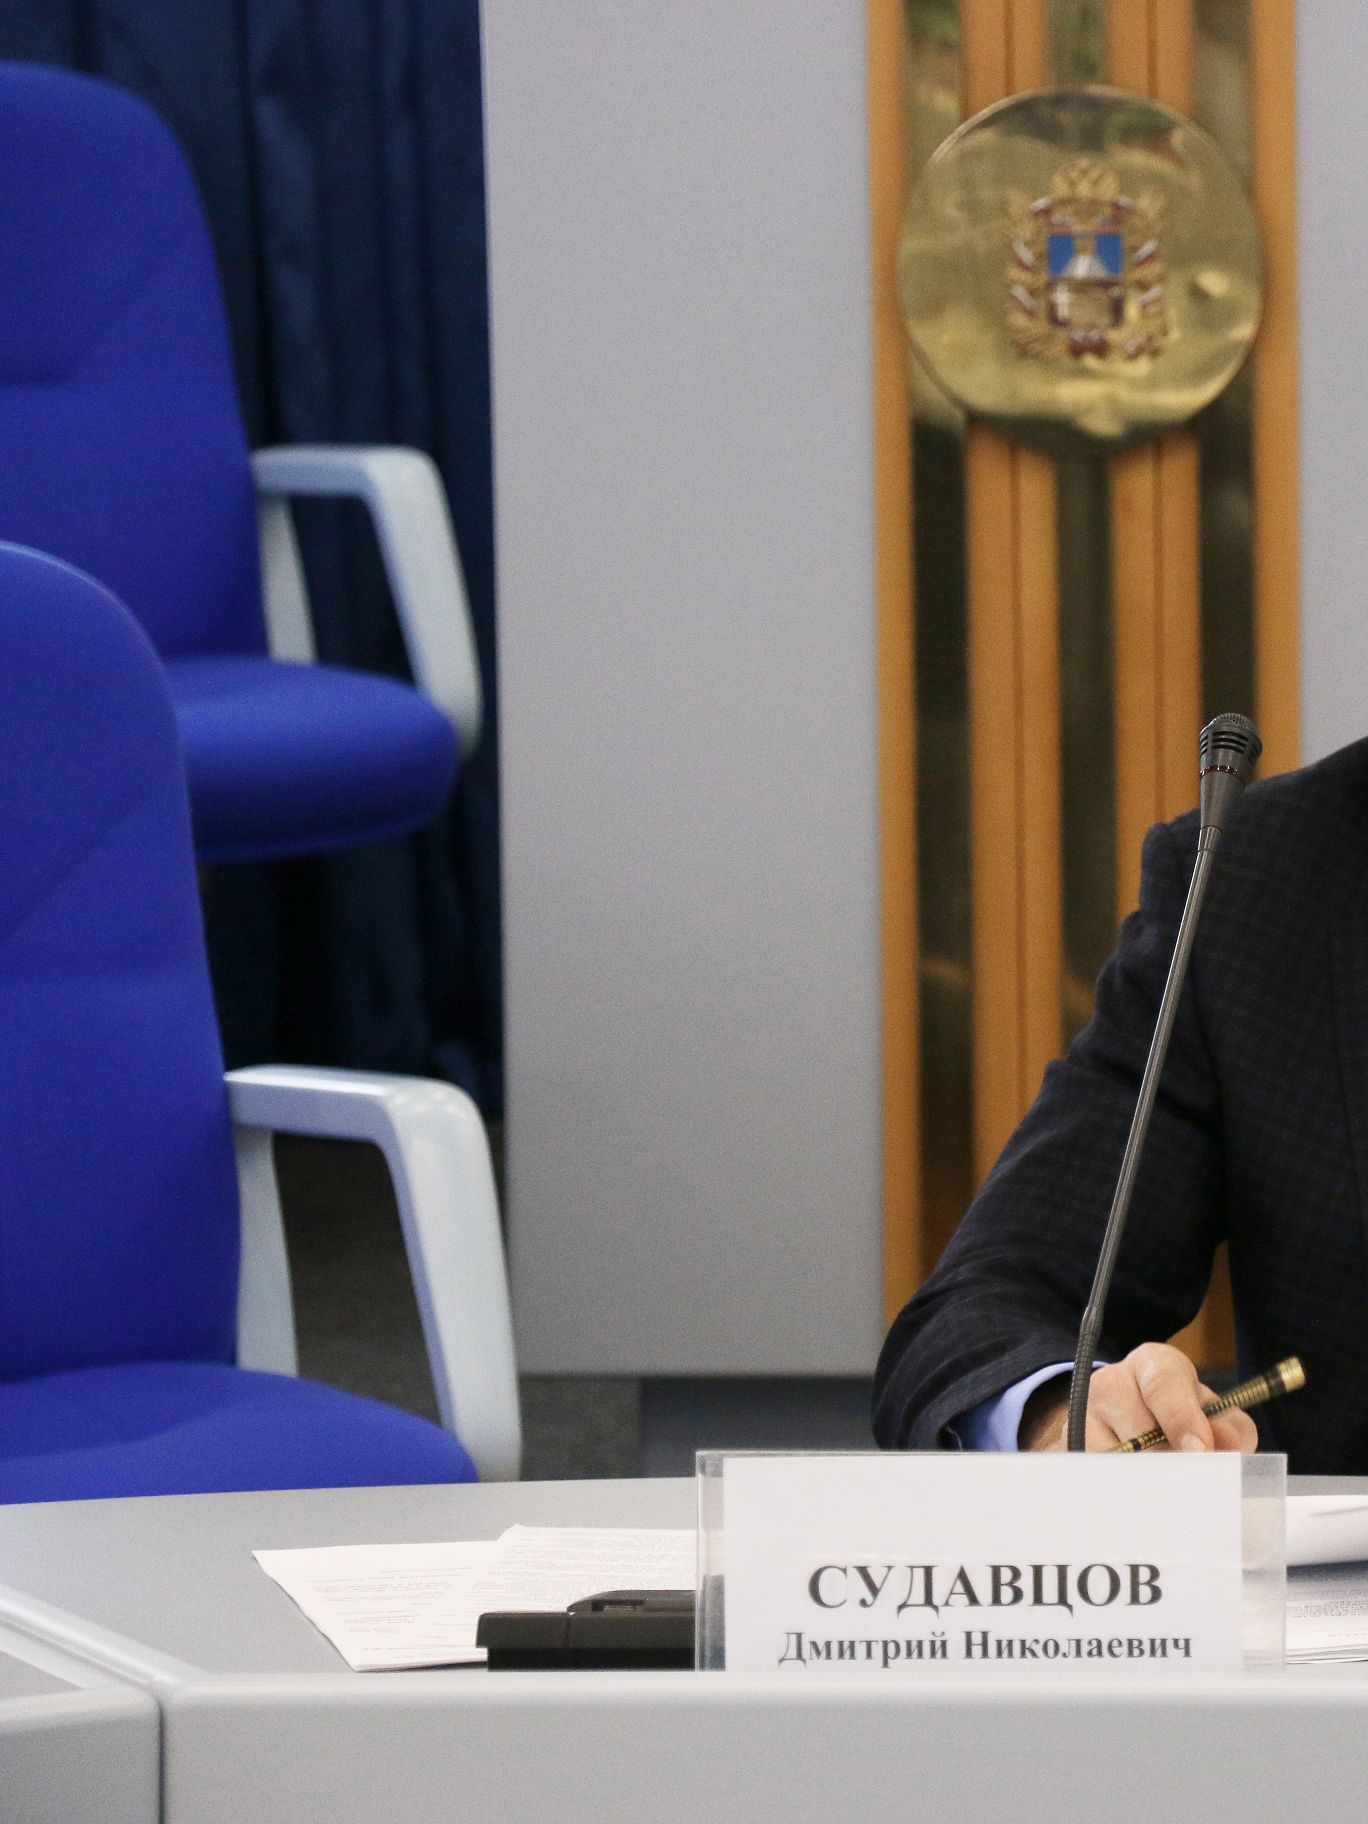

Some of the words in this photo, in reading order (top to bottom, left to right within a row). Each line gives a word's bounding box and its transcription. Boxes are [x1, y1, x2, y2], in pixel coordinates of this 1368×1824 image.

[808, 1563, 1163, 1619] СУДАВЦОВ
[778, 1631, 949, 1668] Дмитрий
[962, 1630, 1192, 1660] Николаевич
